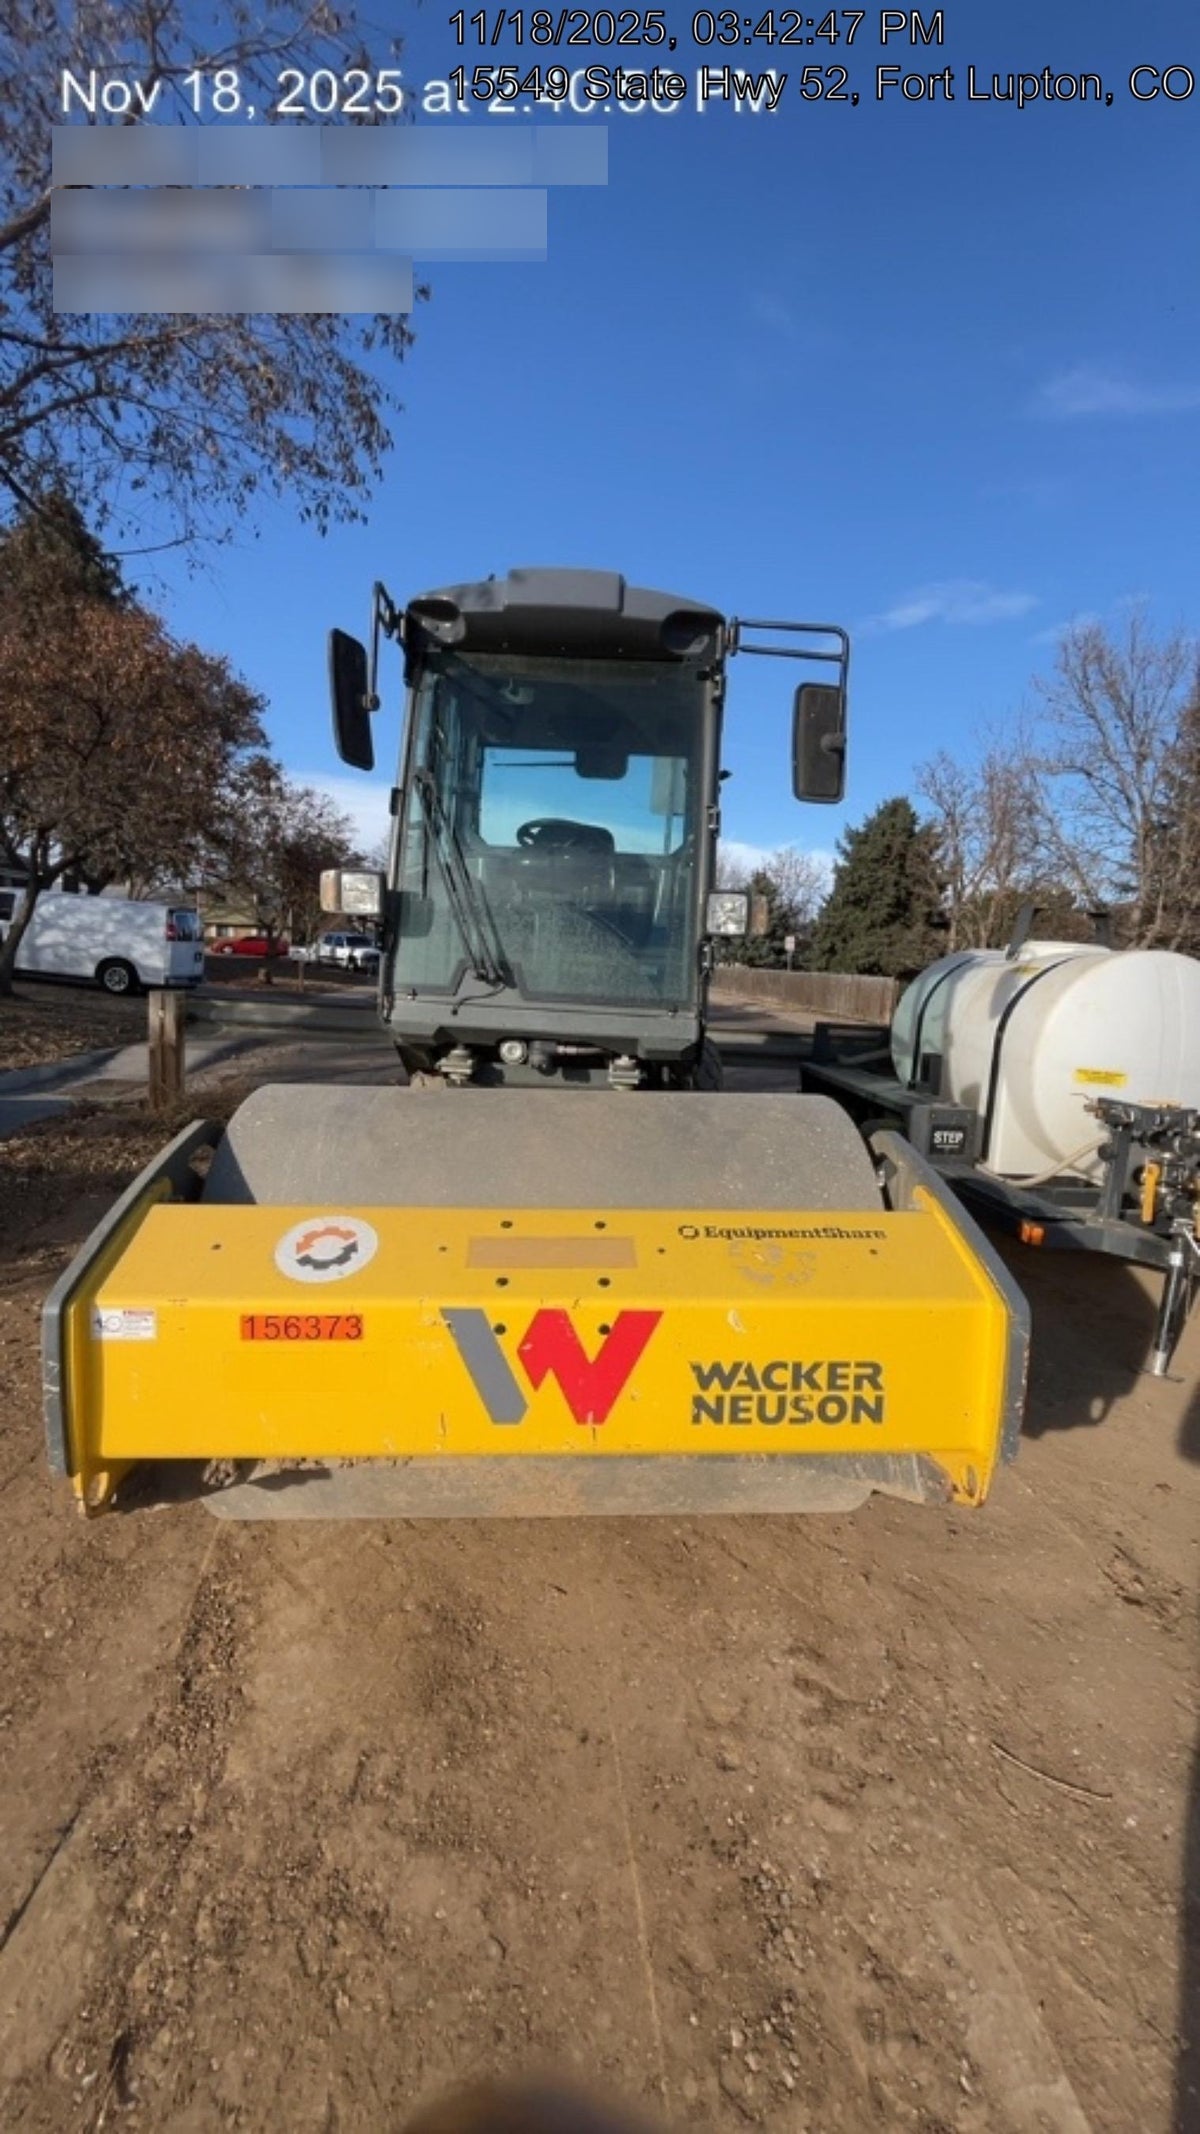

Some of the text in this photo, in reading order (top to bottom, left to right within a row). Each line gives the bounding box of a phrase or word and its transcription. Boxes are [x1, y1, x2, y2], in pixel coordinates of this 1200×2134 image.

[933, 1130, 964, 1144] STEP
[703, 1226, 887, 1241] EquipmentShare
[243, 1315, 363, 1341] 156373
[689, 1361, 884, 1392] WACKER
[691, 1394, 884, 1425] NEUSON
